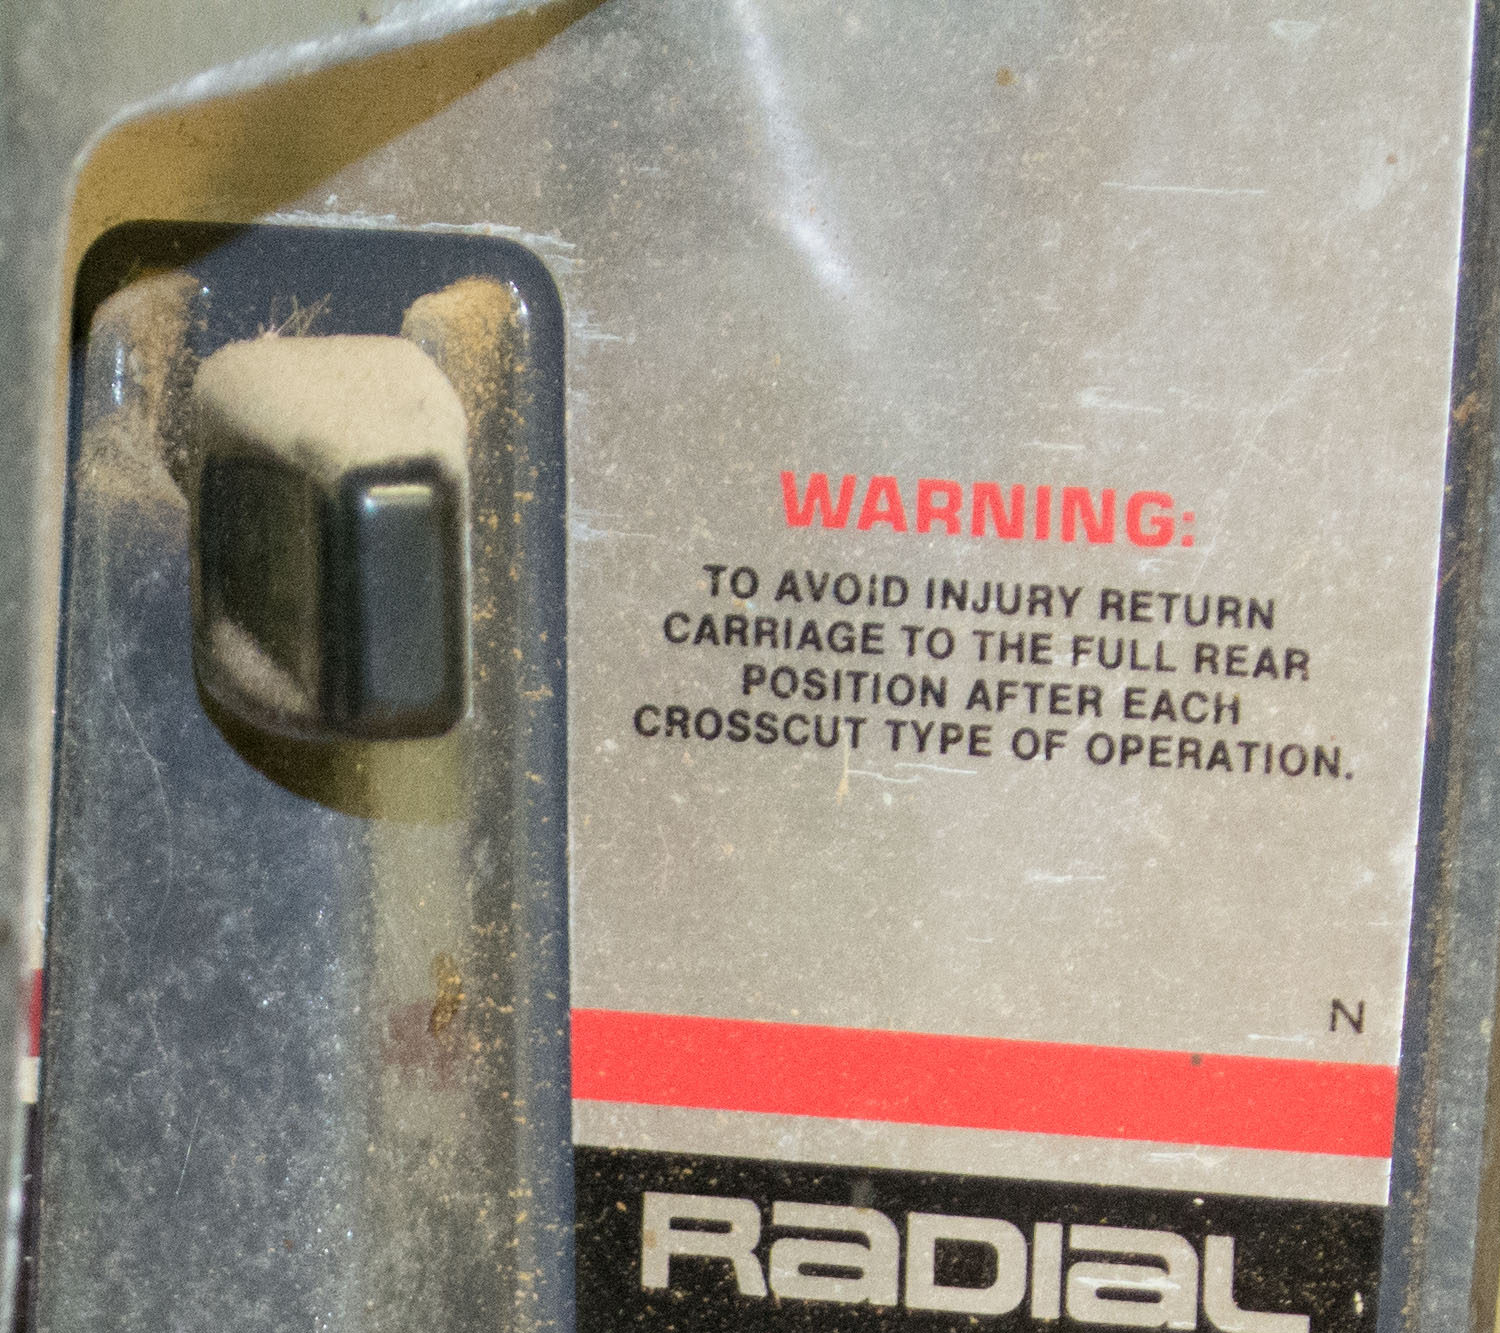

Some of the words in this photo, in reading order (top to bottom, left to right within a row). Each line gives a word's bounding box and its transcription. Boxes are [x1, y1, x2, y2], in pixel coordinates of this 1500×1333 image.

[780, 471, 1197, 548] WARNING:
[702, 564, 760, 600] TO
[775, 569, 911, 607] AVOID
[926, 575, 1083, 618] INJURY
[1099, 587, 1275, 631] RETURN
[663, 611, 886, 656] CARRIAGE
[901, 624, 957, 661] TO
[973, 629, 1053, 666] THE
[1071, 635, 1177, 672] FULL
[1194, 642, 1311, 681] REAR
[742, 663, 948, 709] POSITION
[966, 677, 1103, 718] AFTER
[1123, 686, 1241, 725] EACH
[633, 704, 868, 749] CROSSCUT
[885, 718, 994, 757] TYPE
[1011, 726, 1068, 762] OF
[1085, 732, 1353, 781] OPERATION.
[1329, 998, 1366, 1034] N
